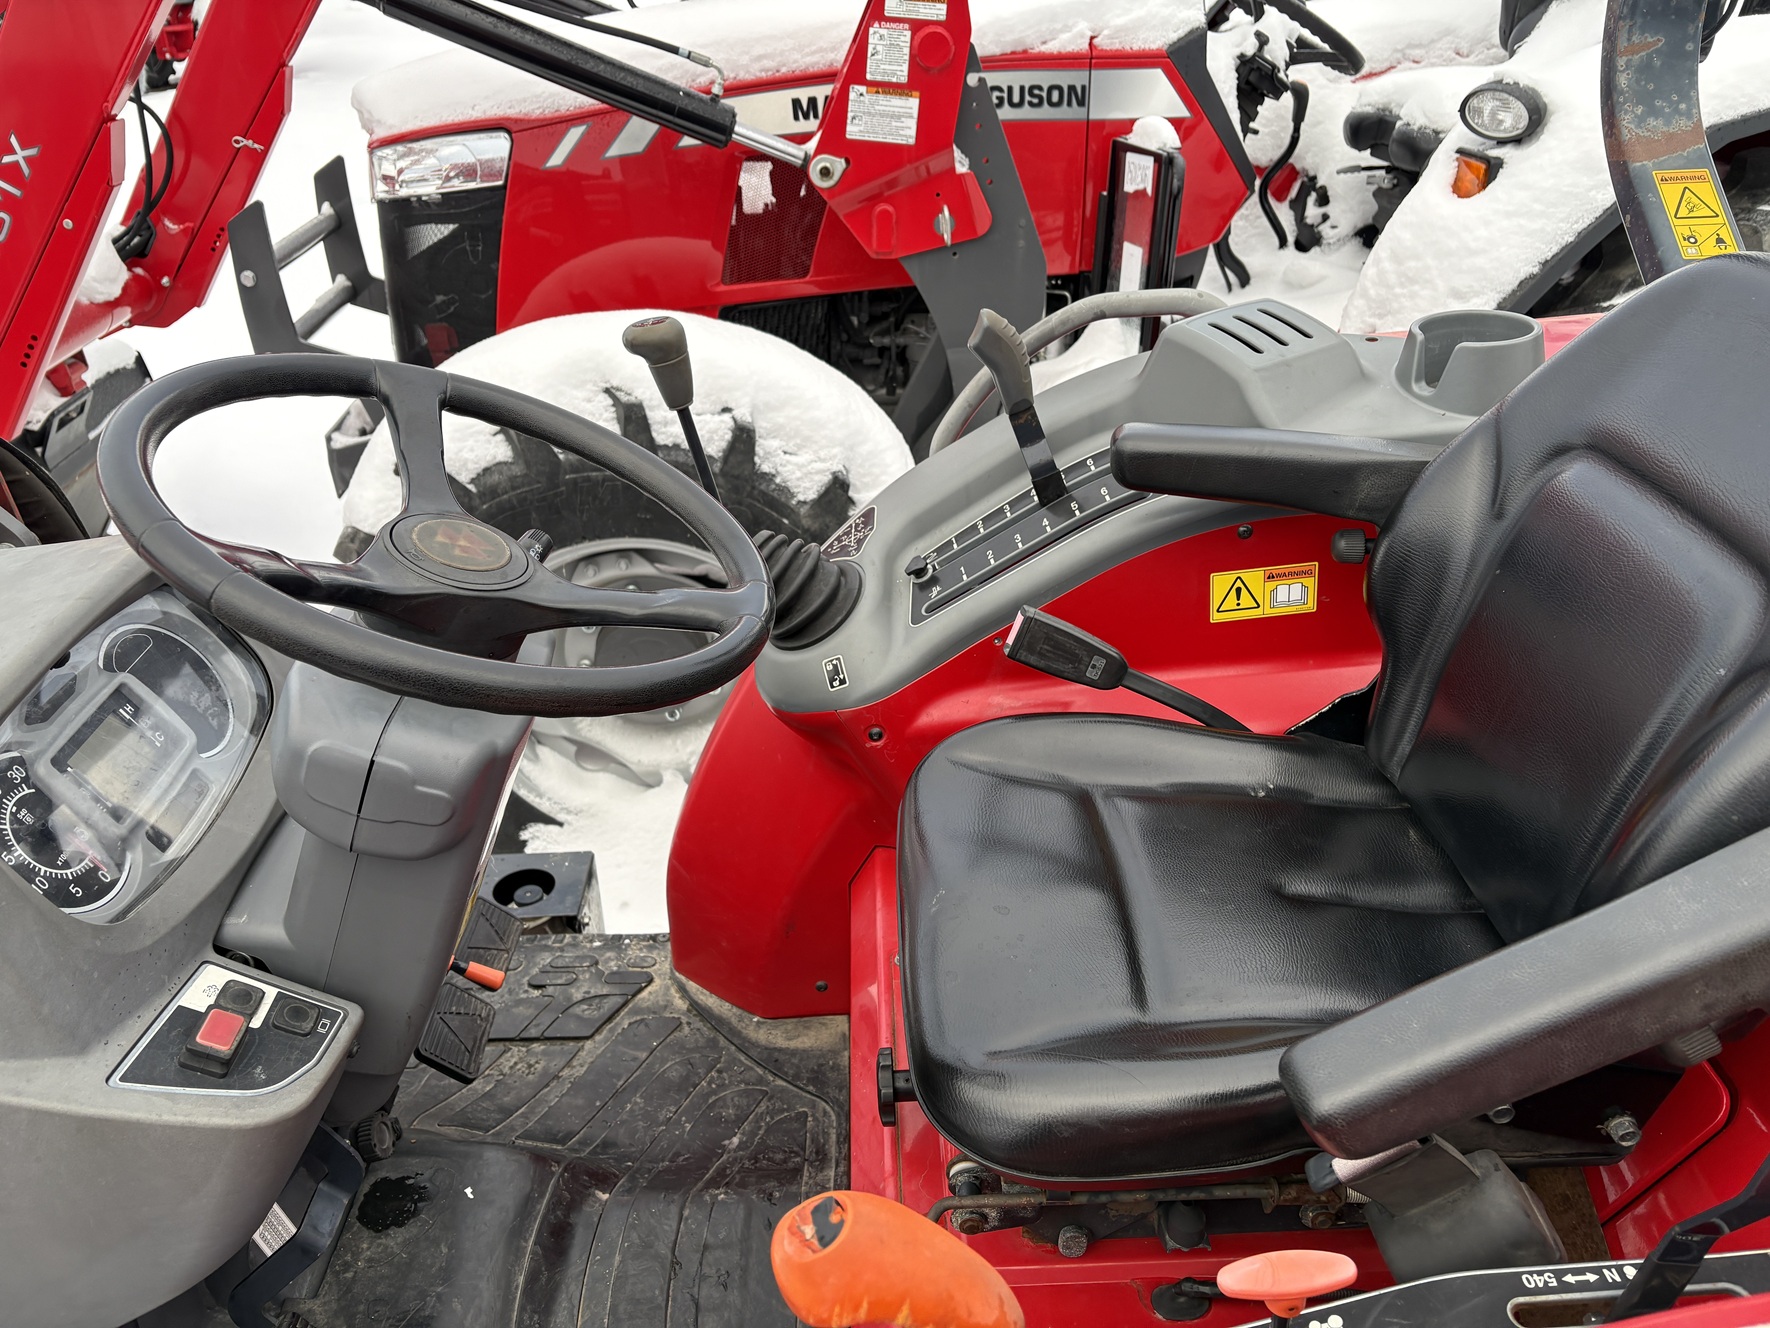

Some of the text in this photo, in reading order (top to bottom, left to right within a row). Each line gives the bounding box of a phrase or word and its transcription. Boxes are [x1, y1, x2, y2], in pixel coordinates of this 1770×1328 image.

[880, 21, 909, 30] DANGER
[1003, 504, 1010, 513] 3
[1086, 458, 1094, 466] 6
[986, 550, 994, 559] 2
[1014, 533, 1022, 543] 3
[1042, 518, 1050, 527] 4
[1070, 501, 1079, 511] 5
[1100, 487, 1108, 496] 6
[1274, 569, 1313, 579] WARNING
[123, 703, 135, 714] H
[155, 732, 165, 741] C
[7, 765, 26, 784] 30
[16, 808, 28, 820] 540
[98, 870, 111, 883] 0
[31, 876, 49, 895] 10
[68, 883, 83, 897] 5
[1521, 1268, 1622, 1289] N 540
